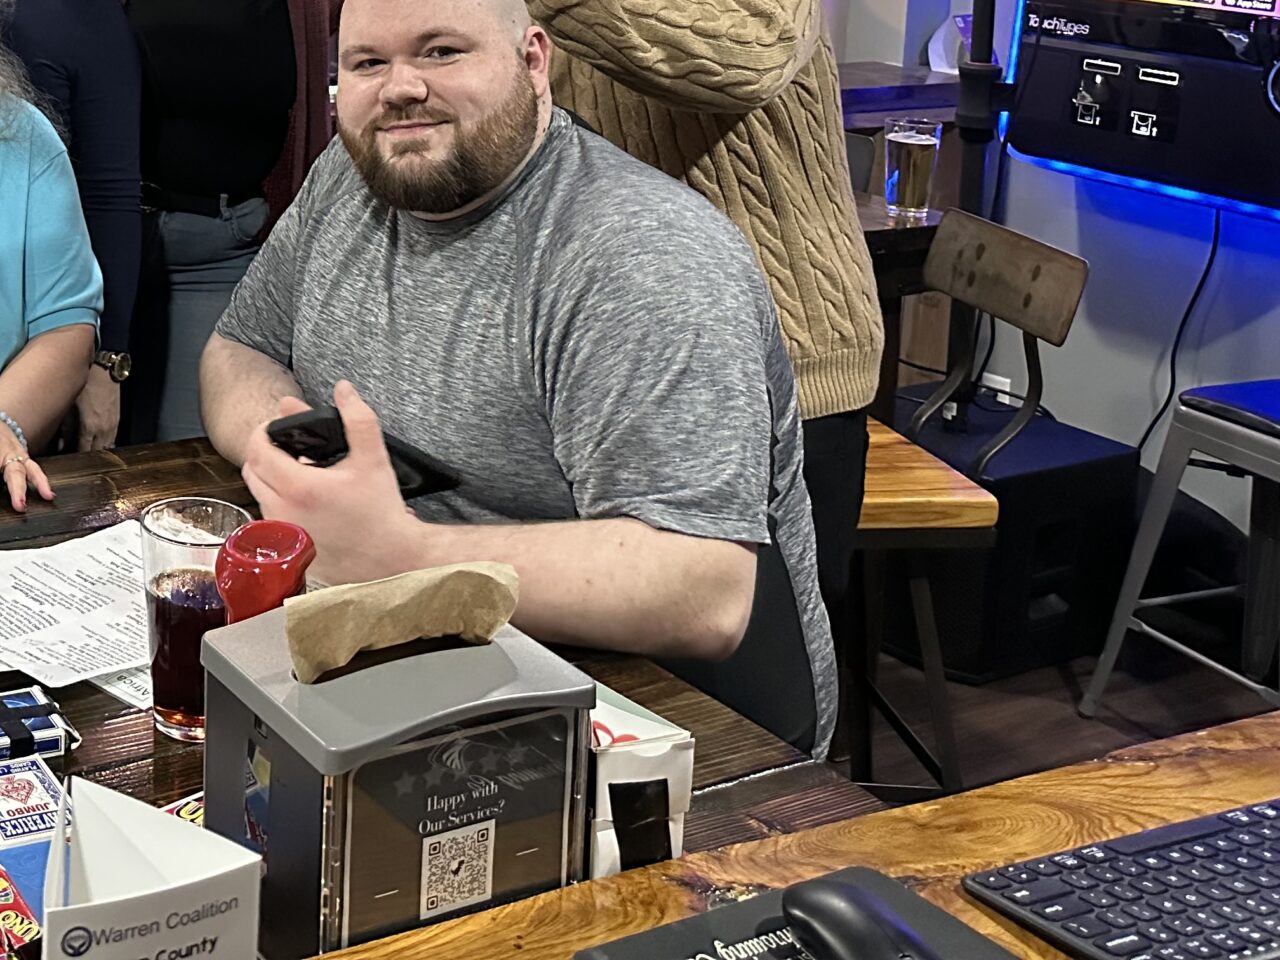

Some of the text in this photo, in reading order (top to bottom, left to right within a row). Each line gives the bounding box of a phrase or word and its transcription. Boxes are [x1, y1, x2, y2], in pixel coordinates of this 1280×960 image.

[116, 674, 152, 698] Africa
[6, 801, 52, 818] JUMBO
[426, 792, 467, 812] Happy
[472, 780, 499, 800] with
[418, 799, 506, 835] Our Services?
[92, 897, 239, 946] Warren Coalition
[155, 935, 219, 960] County
